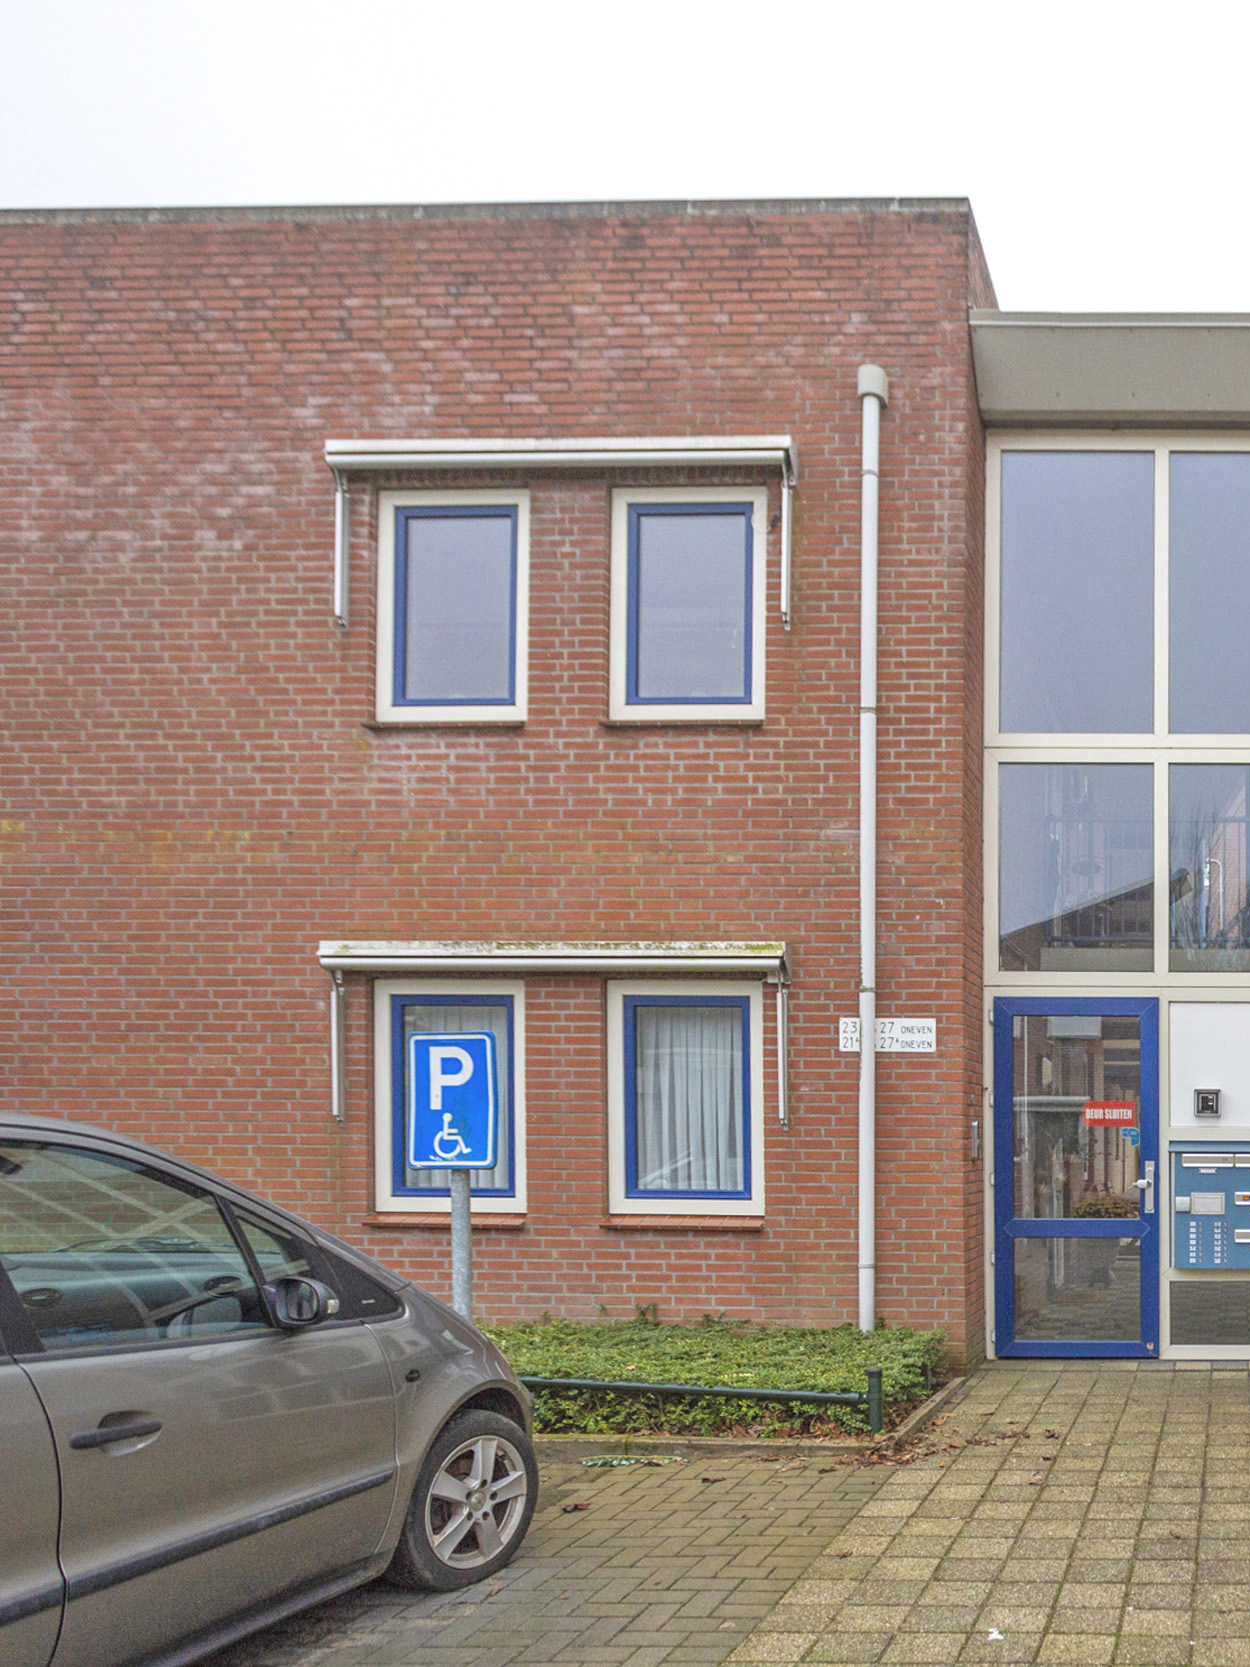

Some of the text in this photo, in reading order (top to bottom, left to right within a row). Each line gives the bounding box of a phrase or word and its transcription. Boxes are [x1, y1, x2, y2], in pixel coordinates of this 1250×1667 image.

[842, 1022, 858, 1033] 23
[880, 1022, 895, 1033] 27
[901, 1025, 933, 1034] ONEVEN
[901, 1040, 933, 1049] ONEVEN
[429, 1046, 474, 1111] P
[1085, 1109, 1132, 1119] DEUR SLUITEN
